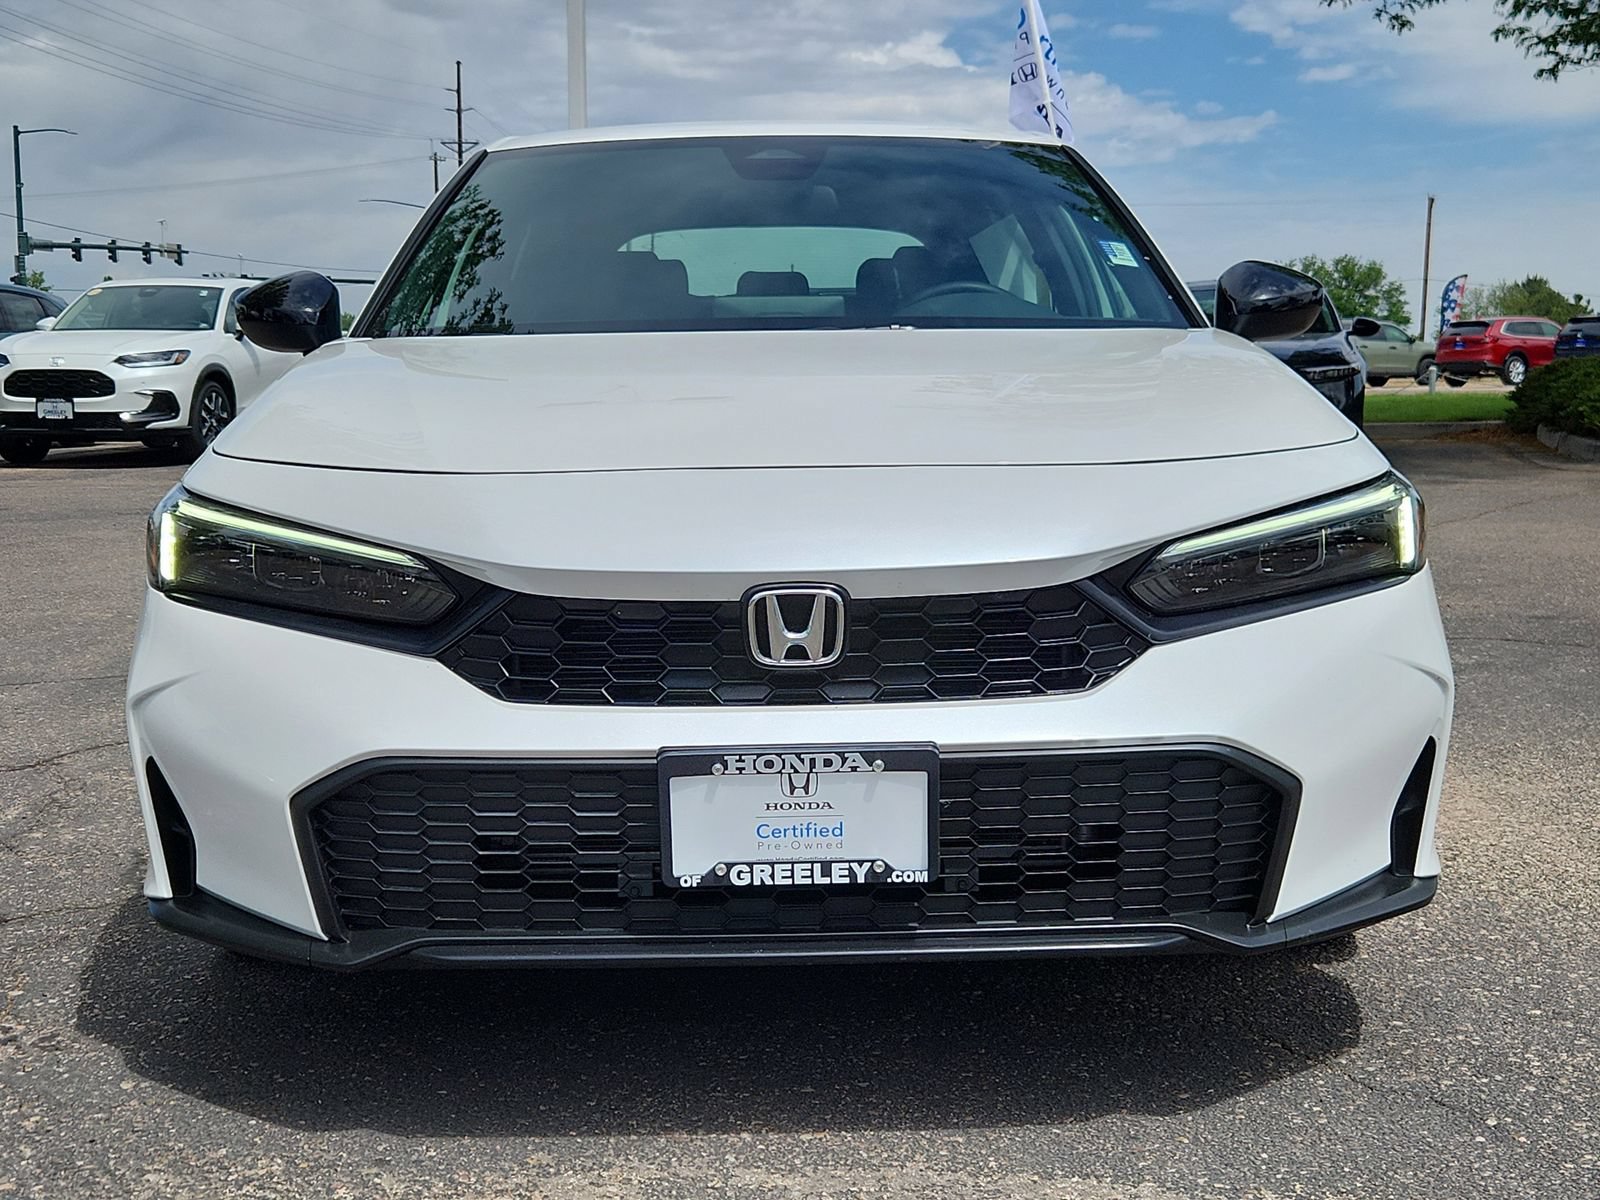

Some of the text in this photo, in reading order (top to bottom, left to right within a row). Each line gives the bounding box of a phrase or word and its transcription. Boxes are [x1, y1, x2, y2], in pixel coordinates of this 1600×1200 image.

[723, 752, 873, 775] HONDA
[764, 801, 835, 811] HONDA
[756, 821, 844, 839] Certified
[757, 840, 843, 851] Pre-Owned
[680, 862, 929, 888] OF GREELEY .COM
